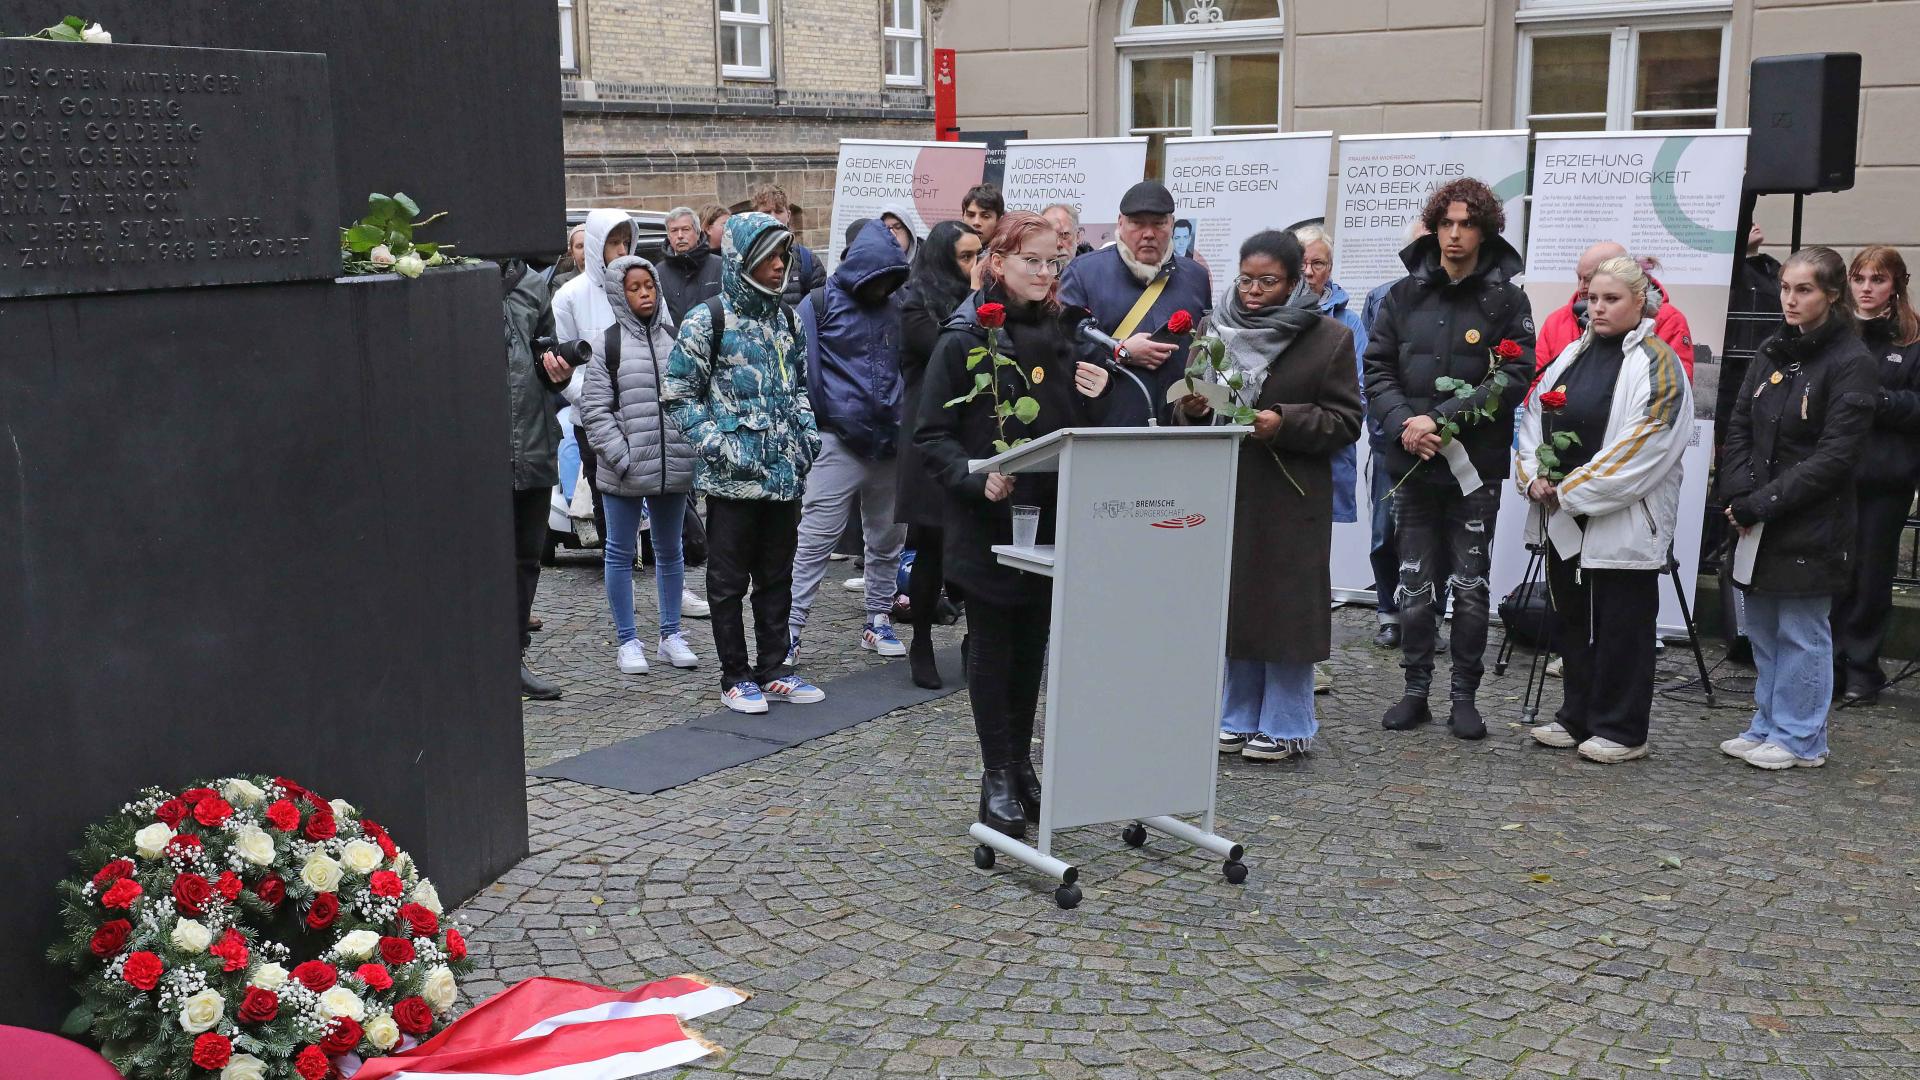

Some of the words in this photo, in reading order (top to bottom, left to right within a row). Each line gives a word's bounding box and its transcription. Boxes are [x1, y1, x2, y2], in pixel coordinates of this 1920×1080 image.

[60, 97, 183, 118] GOLDBERG
[85, 122, 203, 141] GOLDBERG
[845, 158, 913, 169] GEDENKEN
[1011, 157, 1077, 169] JÜDISCHER
[1545, 153, 1644, 167] ERZIEHUNG
[1172, 165, 1221, 177] GEORG
[1225, 163, 1269, 176] ELSER
[1347, 165, 1389, 178] CATO
[1392, 163, 1465, 177] BONTJES
[843, 173, 861, 182] AN
[864, 173, 883, 183] DIE
[886, 174, 934, 184] REICHS-
[1009, 173, 1086, 184] WIDERSTAND
[1542, 172, 1577, 185] ZUR
[1581, 170, 1692, 185] MÜNDIGKEIT
[842, 186, 939, 199] POGROMNACHT
[1171, 181, 1225, 193] ALLEINE
[1228, 179, 1278, 192] GEGEN
[1346, 183, 1376, 195] VAN
[1380, 182, 1420, 194] BEEK
[1007, 189, 1021, 198] IM
[1023, 188, 1085, 199] NATIONAL-
[1173, 197, 1216, 209] HITLER
[1344, 216, 1366, 228] BEI
[26, 222, 104, 241] DIESER
[121, 218, 186, 238] STADT
